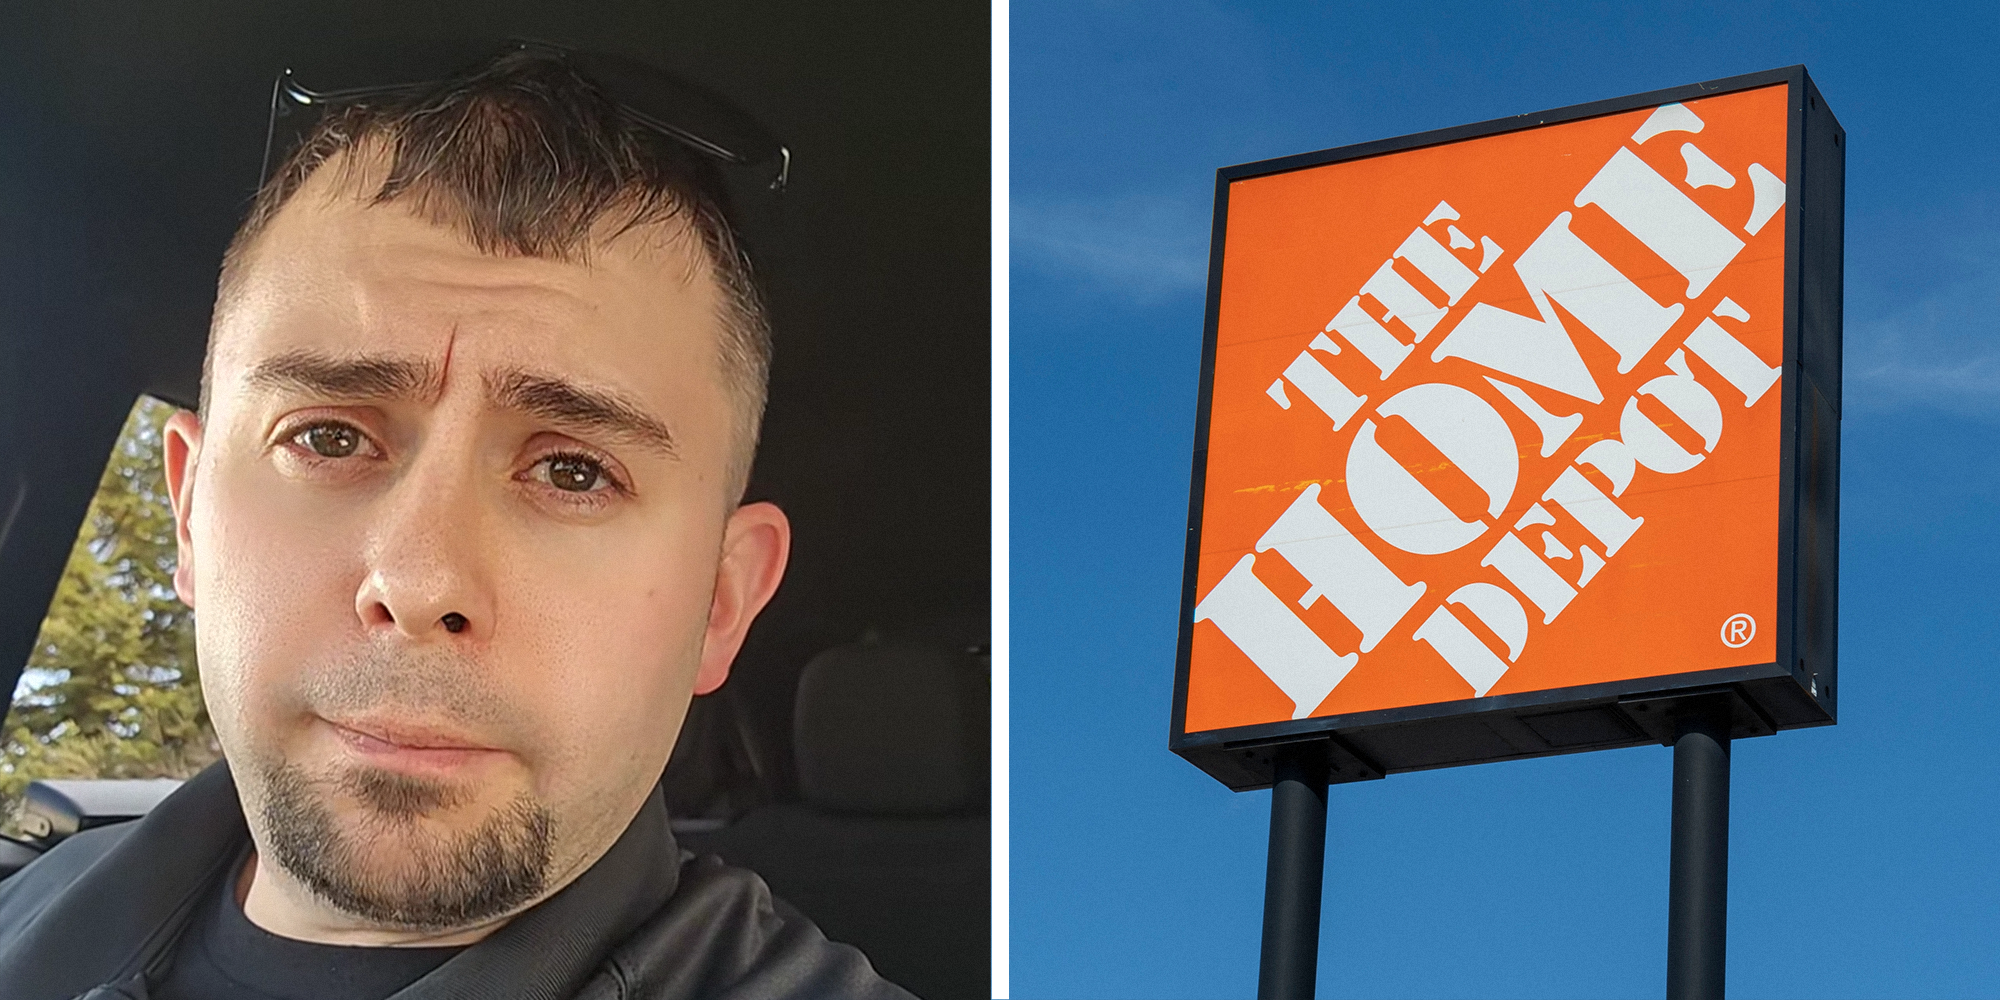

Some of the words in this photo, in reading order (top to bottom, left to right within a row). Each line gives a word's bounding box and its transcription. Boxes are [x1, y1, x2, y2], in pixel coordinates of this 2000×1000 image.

[1194, 103, 1787, 720] HOME
[1266, 201, 1504, 431] THE
[1413, 297, 1783, 698] DEPOT
